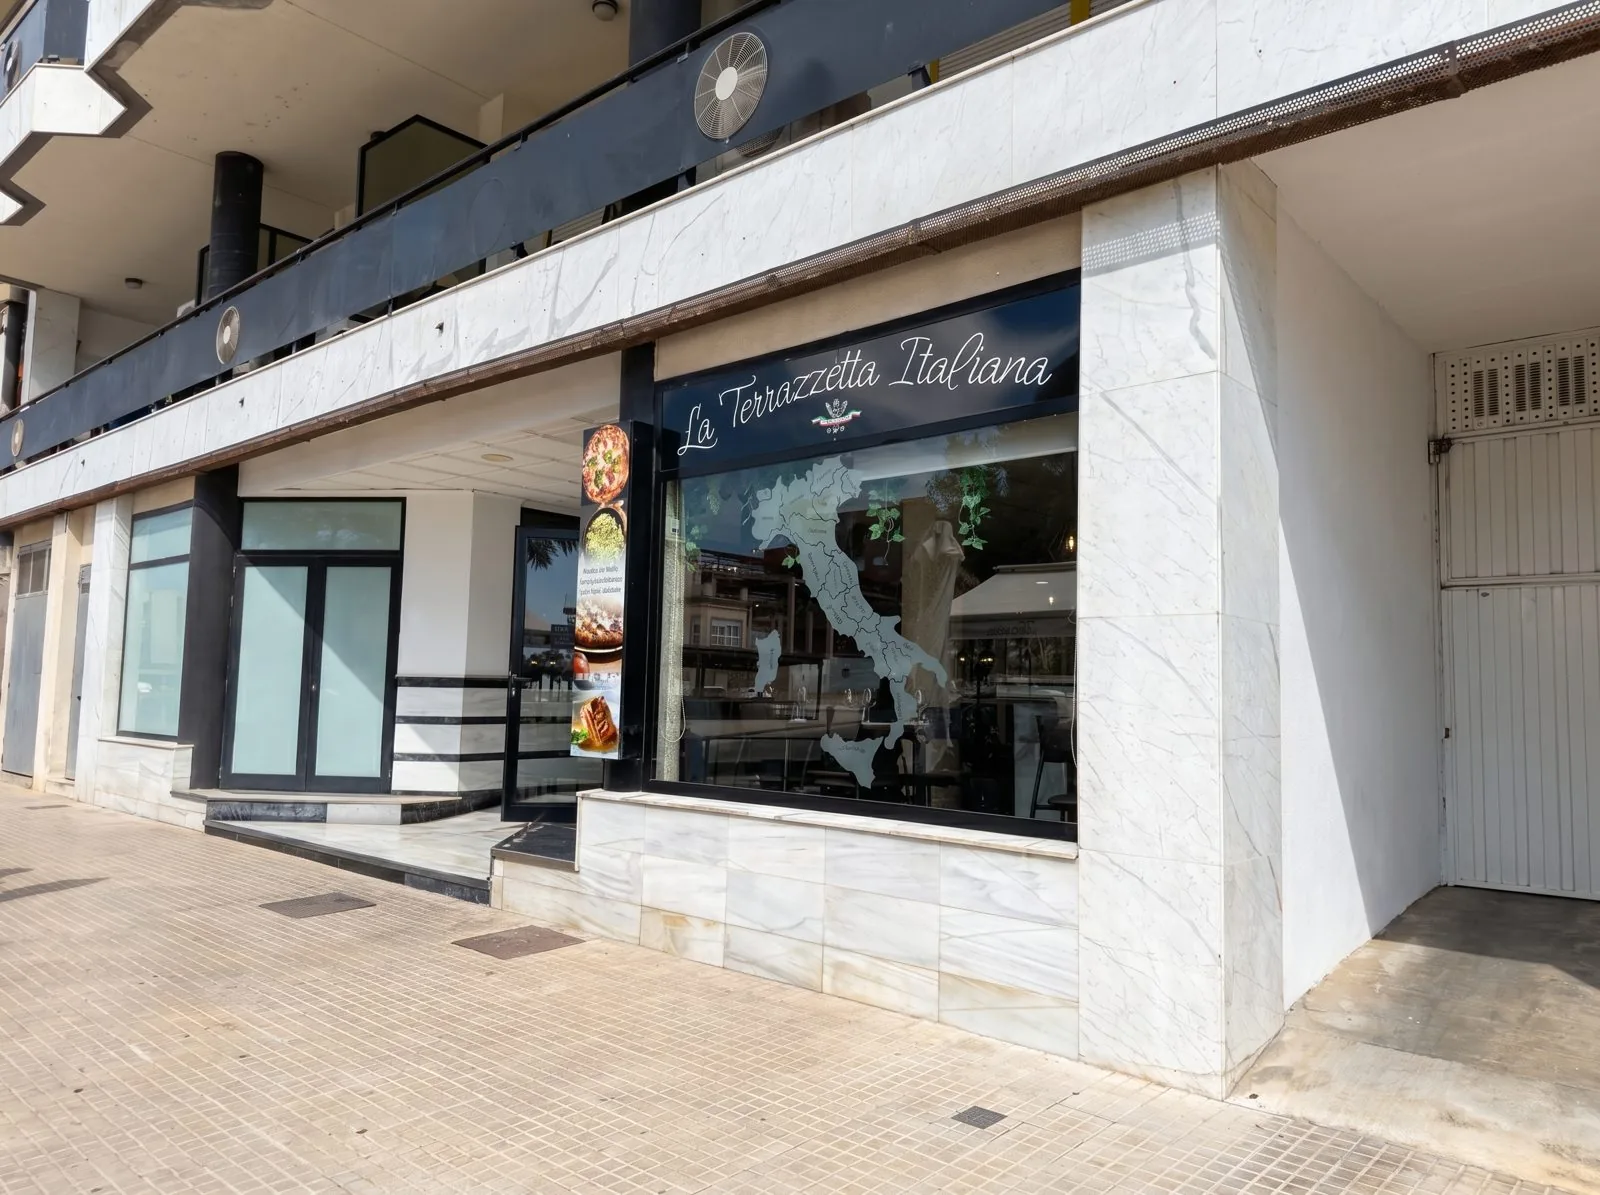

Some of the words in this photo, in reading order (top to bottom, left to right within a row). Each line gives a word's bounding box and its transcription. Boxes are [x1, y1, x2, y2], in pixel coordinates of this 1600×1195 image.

[677, 400, 719, 457] La
[718, 349, 881, 428] Terrazzetta
[888, 332, 1053, 391] Italiana
